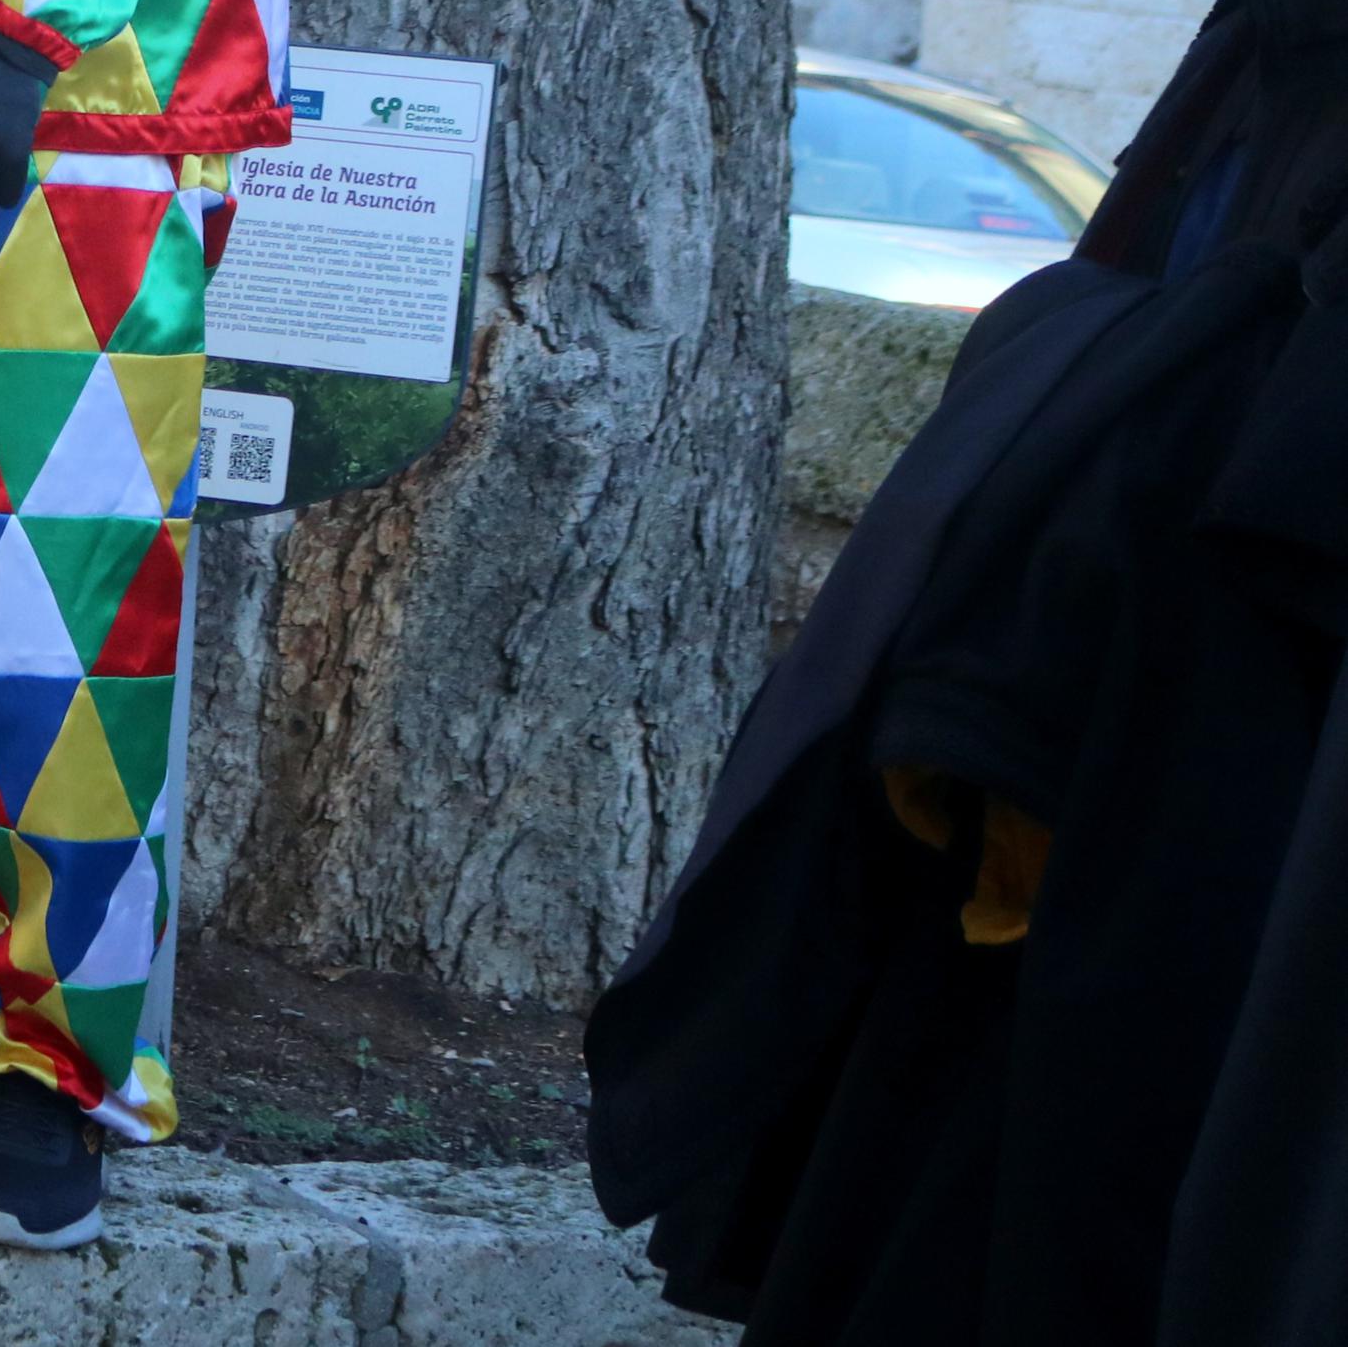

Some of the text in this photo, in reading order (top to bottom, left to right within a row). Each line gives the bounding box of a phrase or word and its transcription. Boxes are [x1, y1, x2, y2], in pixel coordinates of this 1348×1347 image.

[290, 94, 311, 103] ción
[293, 105, 320, 116] ENCIA
[407, 103, 440, 114] ADRI
[405, 122, 463, 136] Palentino
[241, 157, 418, 190] Iglesia de Nuestra
[240, 178, 436, 214] ñora de la Asunción
[203, 406, 244, 420] ENGLISH
